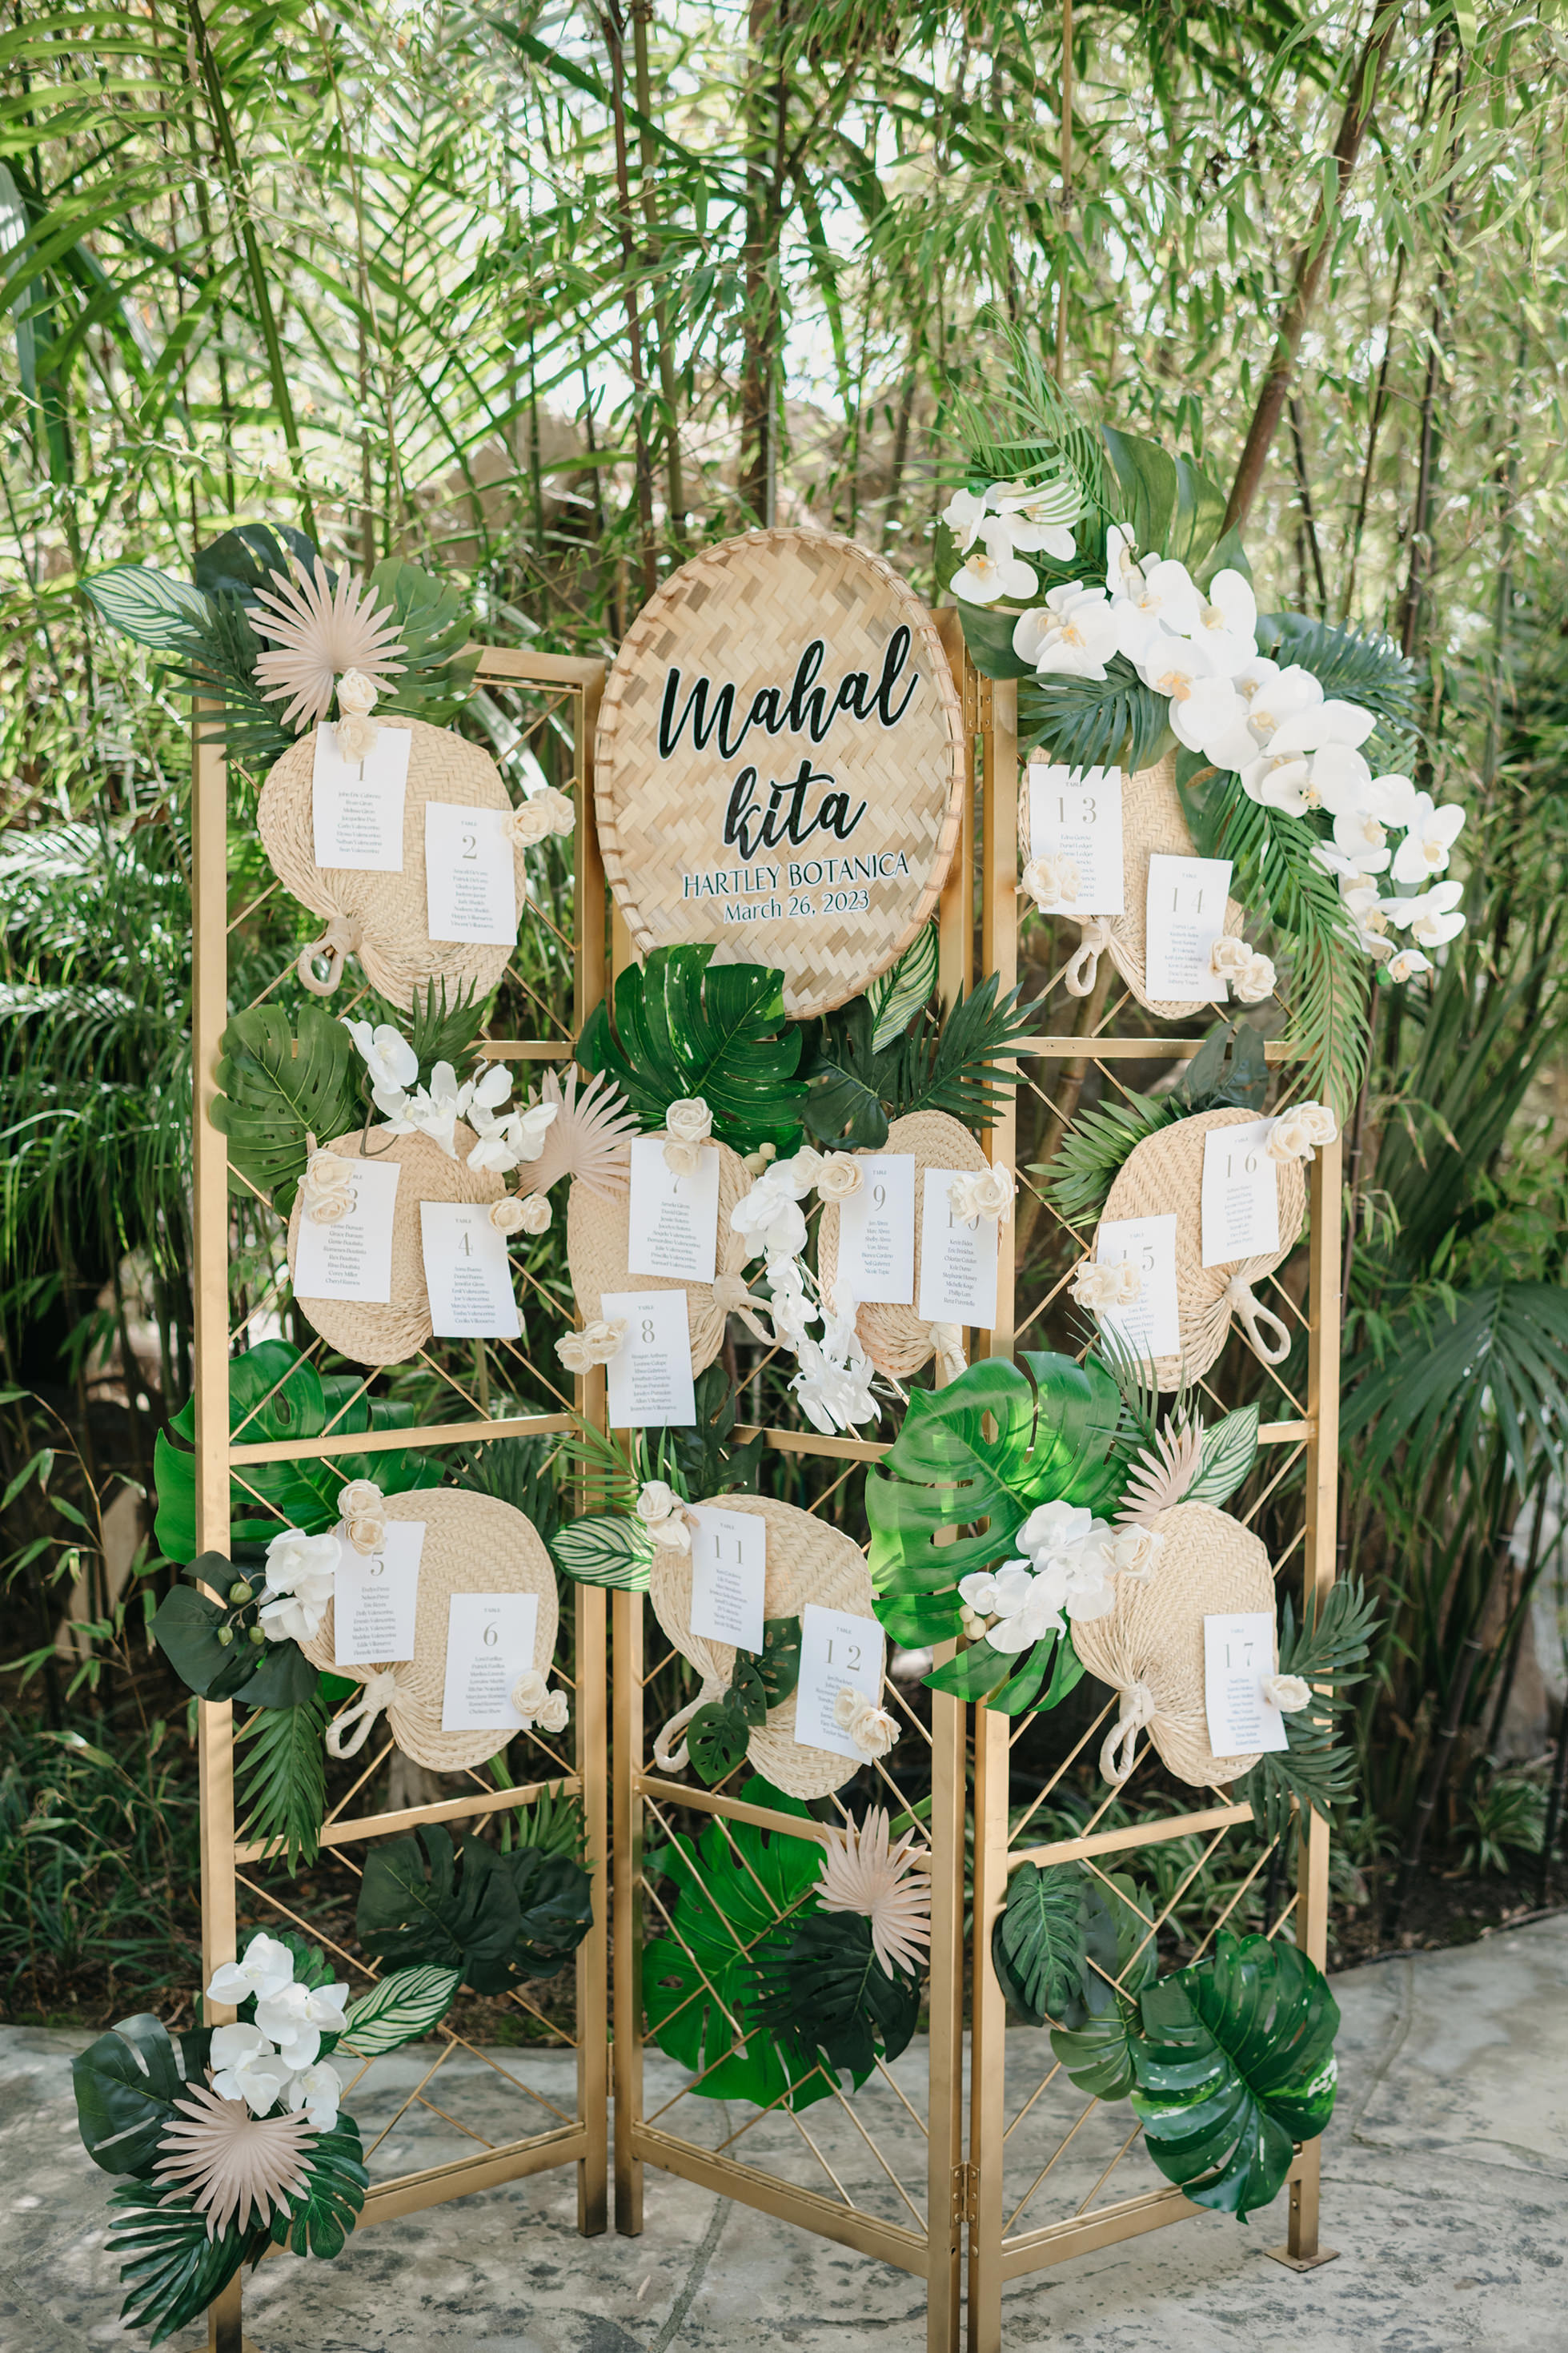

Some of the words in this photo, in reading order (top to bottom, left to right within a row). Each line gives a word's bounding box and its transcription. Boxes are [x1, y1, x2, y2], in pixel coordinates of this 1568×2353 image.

[659, 624, 920, 761] Mahal
[723, 759, 867, 861] kita
[462, 834, 478, 860] 2
[683, 861, 782, 898] HARTLEY
[788, 852, 909, 888] BOTANICA
[724, 900, 782, 924] March
[787, 896, 816, 919] 26,
[822, 890, 870, 914] 2023
[872, 1183, 887, 1211] 9
[458, 1231, 474, 1257] 4
[641, 1319, 656, 1343] 8
[368, 1551, 385, 1577] 5
[483, 1621, 499, 1647] 6
